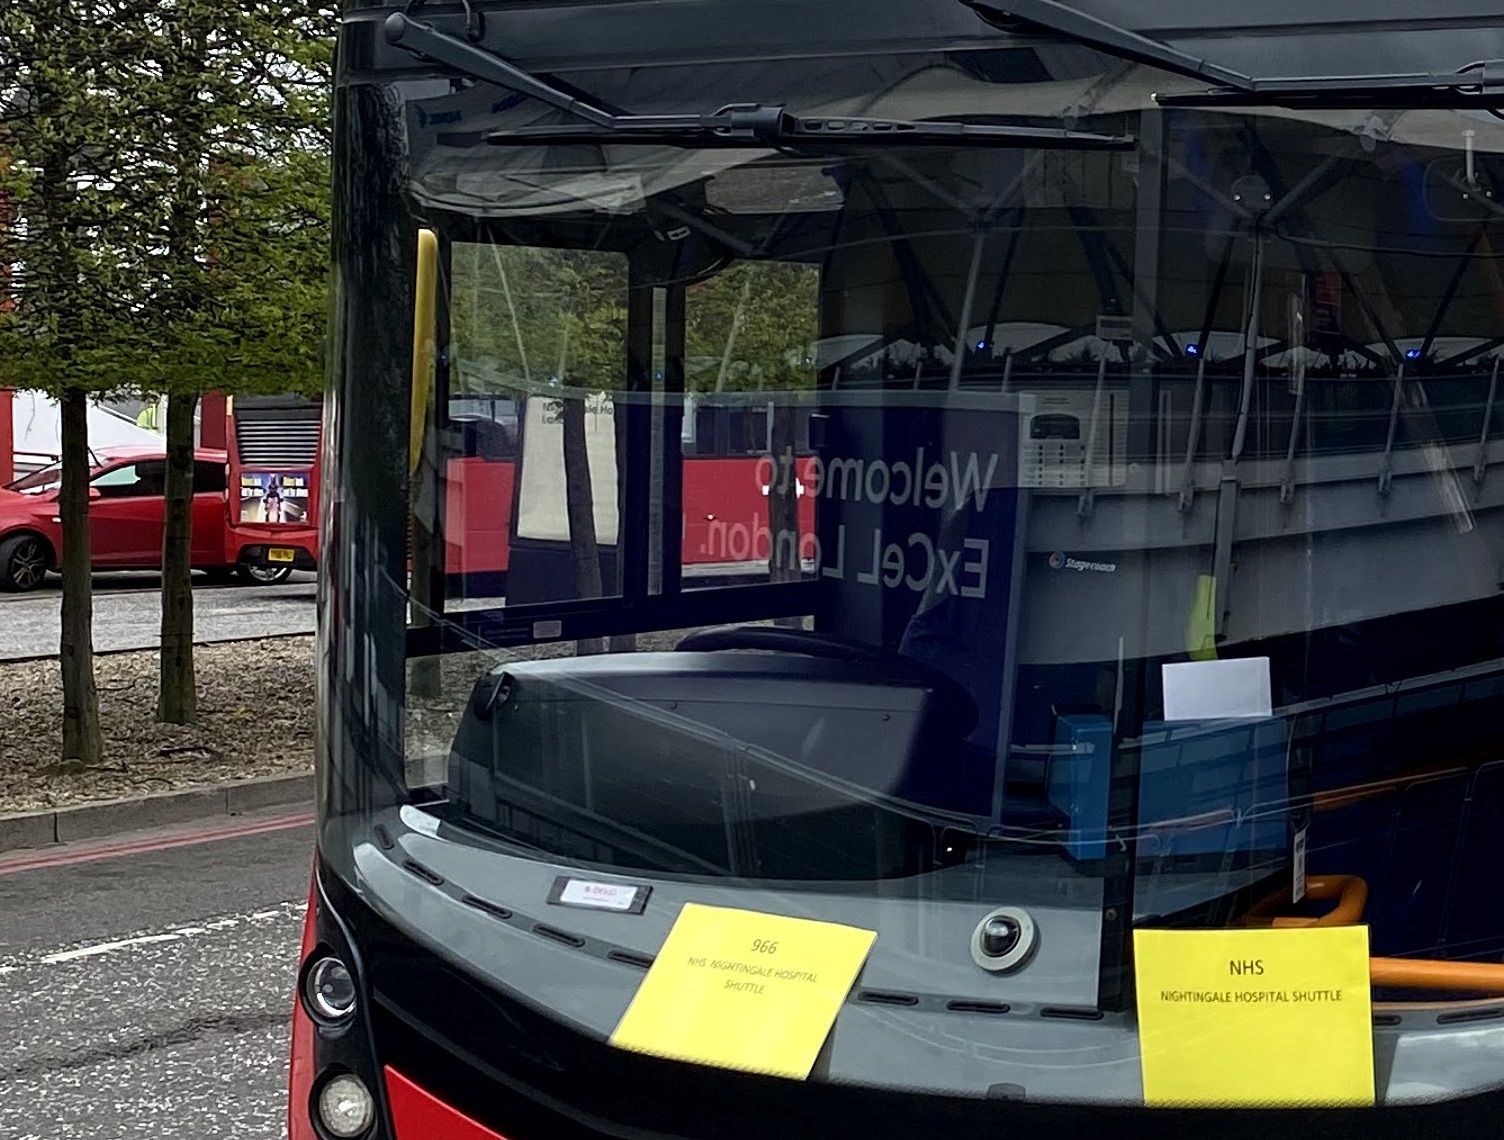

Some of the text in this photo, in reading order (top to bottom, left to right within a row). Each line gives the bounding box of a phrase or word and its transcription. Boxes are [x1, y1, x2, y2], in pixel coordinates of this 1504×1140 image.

[1065, 558, 1116, 573] Stagecoach
[751, 939, 779, 954] 966
[710, 959, 774, 978] NIGHTINGALE
[774, 970, 819, 983] HOSPITAL
[1230, 959, 1264, 975] NHS
[723, 980, 766, 994] SHUTTLE
[1161, 990, 1342, 1003] NIGHTINGALE HOSPITAL SHUTTLE
